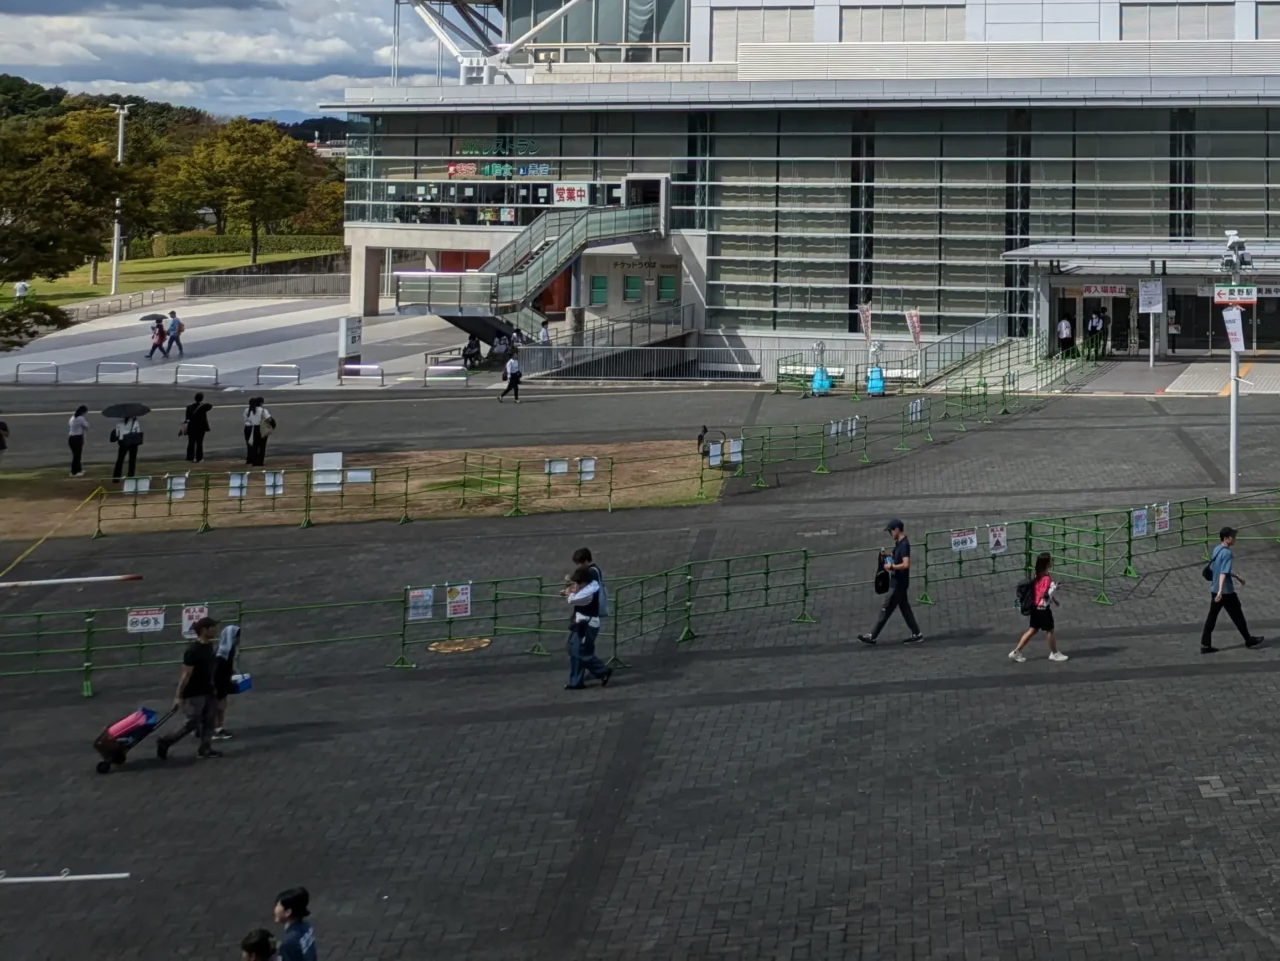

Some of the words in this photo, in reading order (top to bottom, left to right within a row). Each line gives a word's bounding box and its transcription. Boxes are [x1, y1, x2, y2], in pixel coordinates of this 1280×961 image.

[482, 139, 541, 155] レストラン
[555, 187, 586, 202] 営業中
[612, 261, 657, 269] チケットうりば
[1083, 285, 1126, 294] 再入場禁止
[1228, 288, 1253, 296] 愛野駅
